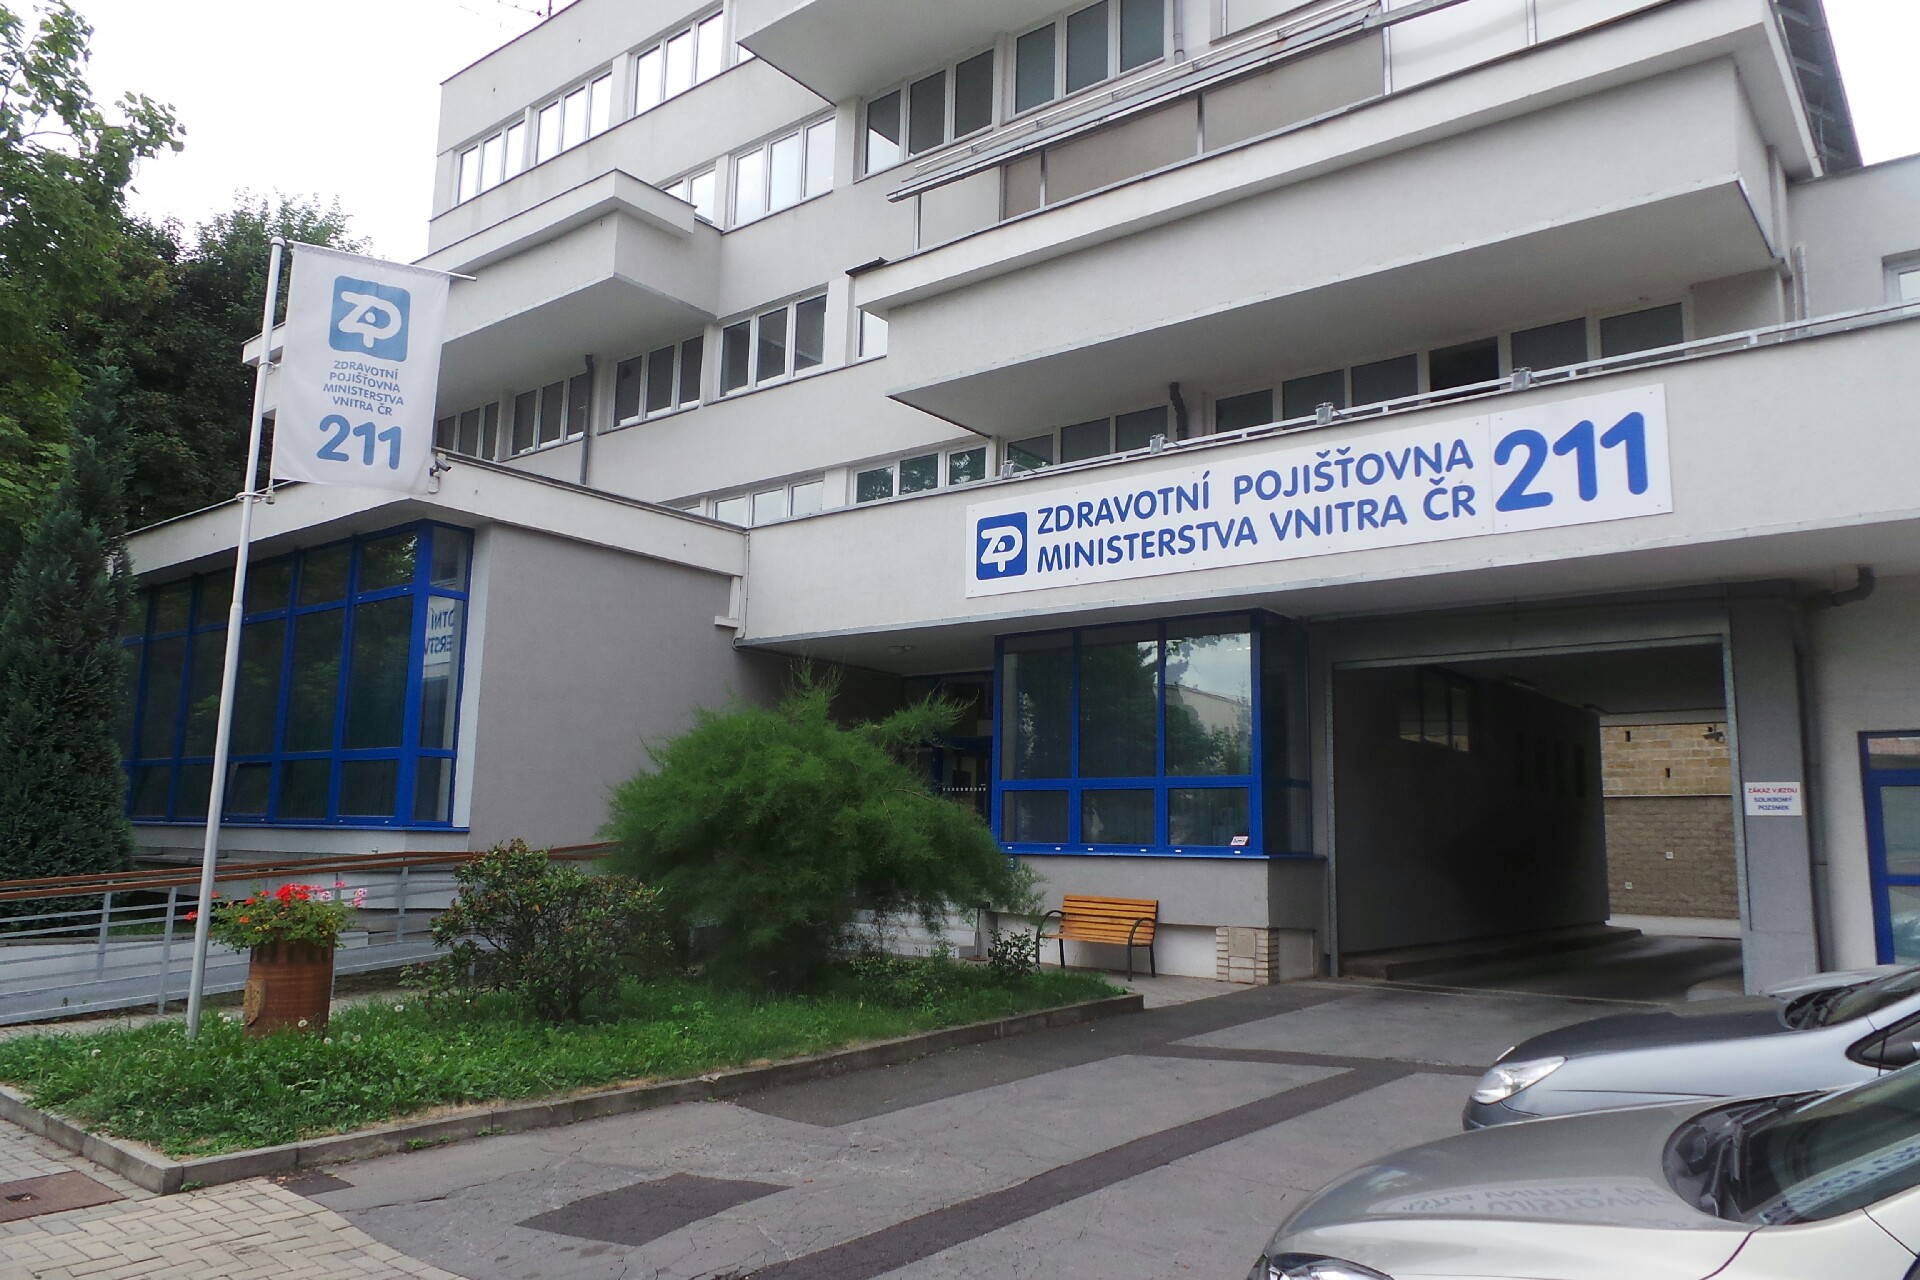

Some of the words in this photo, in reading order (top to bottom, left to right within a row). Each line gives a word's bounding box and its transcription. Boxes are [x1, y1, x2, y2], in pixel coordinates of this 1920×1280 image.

[333, 360, 400, 379] ZDRAVOTNÍ
[329, 371, 401, 392] POJIŠŤOVNA
[323, 383, 404, 405] MINISTERSTVA
[332, 396, 373, 412] VNITRA
[377, 403, 393, 416] ČR
[316, 414, 402, 470] 211
[1493, 411, 1650, 513] 211
[1037, 470, 1211, 535] ZDRAVOTNÍ
[1234, 438, 1475, 504] POJIŠŤOVNA
[1037, 515, 1259, 573] MINISTERSTVA
[1270, 494, 1409, 541] VNITRA
[1423, 476, 1477, 521] ČR
[1748, 786, 1771, 794] ZÁKAZ
